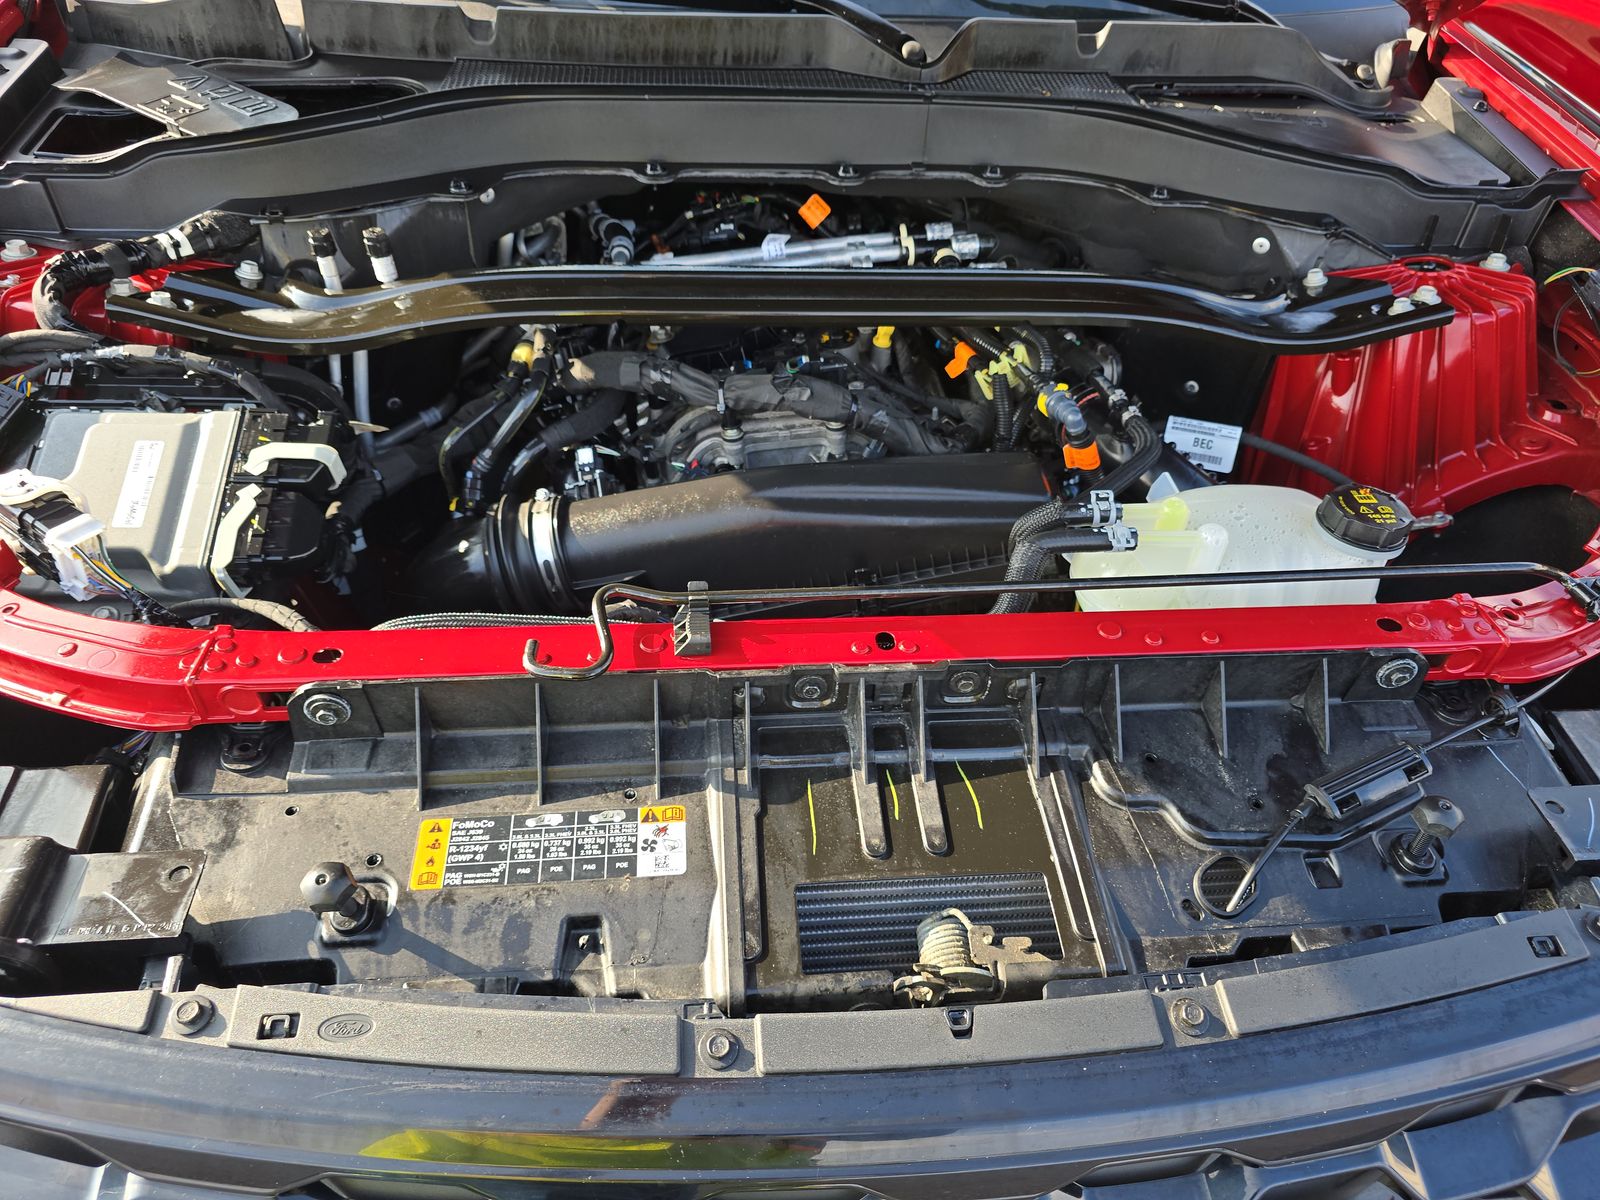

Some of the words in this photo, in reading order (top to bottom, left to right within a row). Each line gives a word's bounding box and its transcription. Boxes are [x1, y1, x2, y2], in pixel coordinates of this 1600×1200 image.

[1192, 437, 1214, 450] BEC
[452, 820, 495, 830] FoMoCo
[563, 839, 571, 847] kg
[449, 844, 489, 853] R-1234yf
[447, 854, 474, 863] (GWP
[474, 853, 484, 861] 4)
[329, 1022, 363, 1036] Ford
